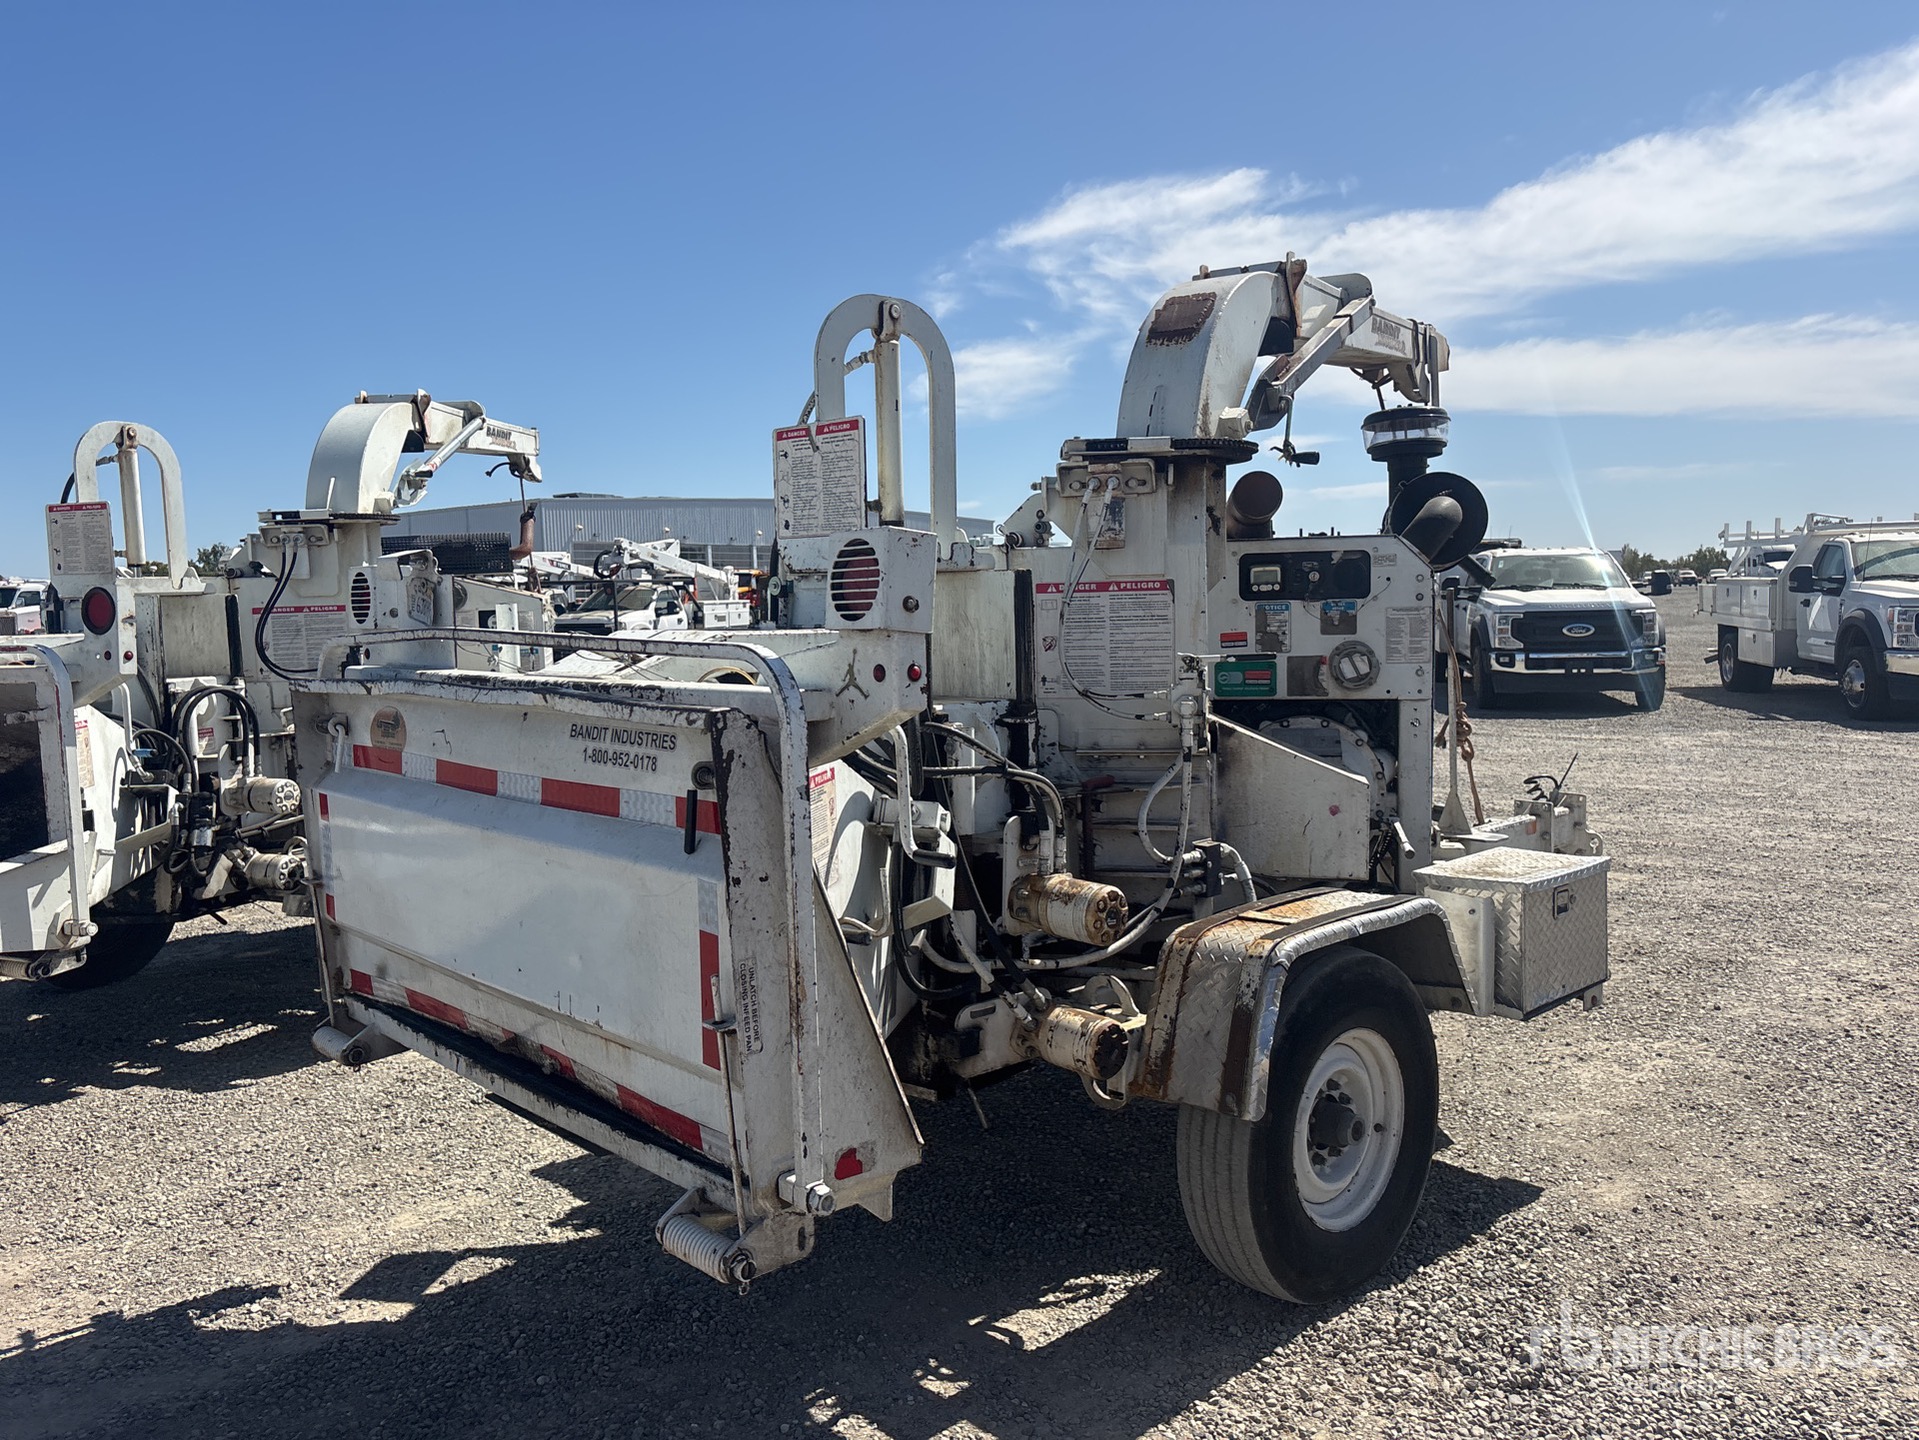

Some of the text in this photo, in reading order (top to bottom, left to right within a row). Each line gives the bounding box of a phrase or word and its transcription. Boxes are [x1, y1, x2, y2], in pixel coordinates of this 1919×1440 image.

[486, 426, 512, 440] BANDIT
[1058, 583, 1097, 592] DGER
[1120, 581, 1161, 590] PELIGRO
[569, 723, 677, 751] BANDIT INDUSTRIES
[582, 747, 658, 772] 1-800-952-0178
[740, 962, 753, 1051] CLOSING INFEED PAN
[748, 966, 760, 1042] UNLATCH BEFORE
